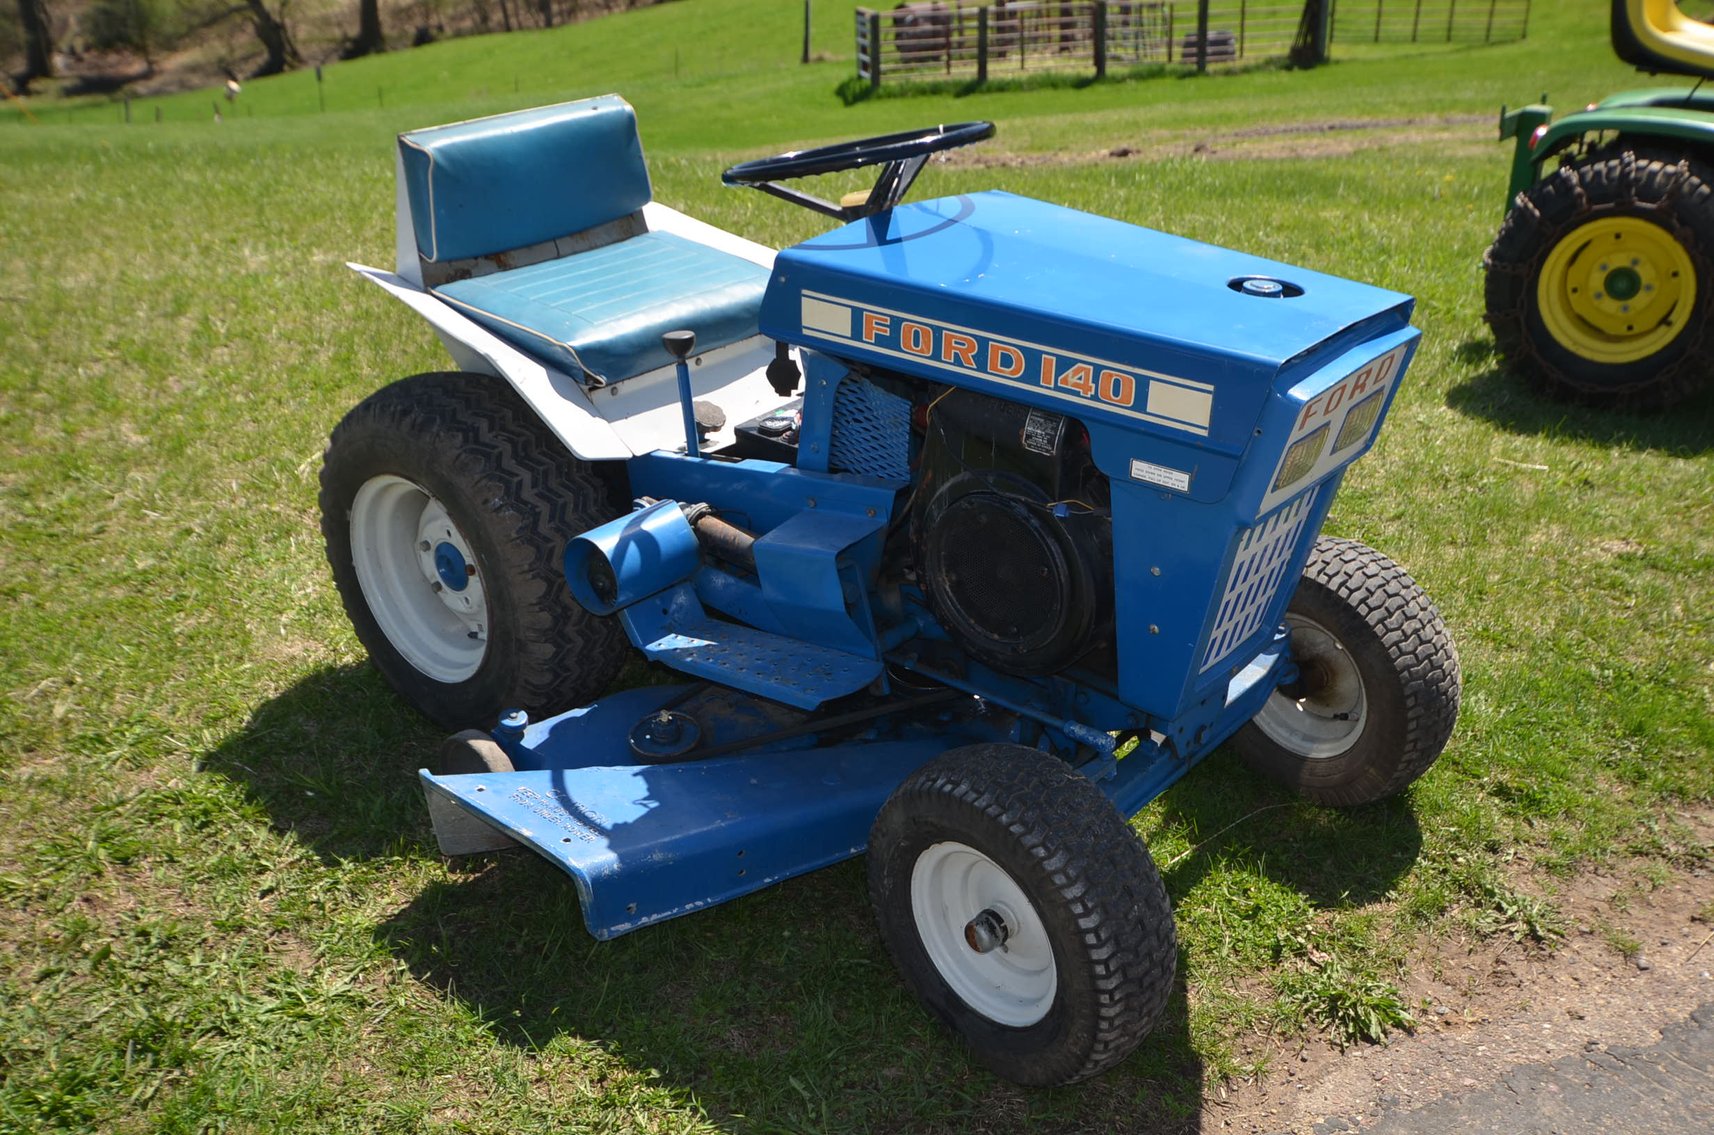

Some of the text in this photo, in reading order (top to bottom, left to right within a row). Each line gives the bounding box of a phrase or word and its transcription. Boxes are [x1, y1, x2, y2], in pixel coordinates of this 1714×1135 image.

[862, 311, 1136, 407] FORD 140
[1298, 353, 1396, 432] FORD
[545, 789, 611, 826] CTION
